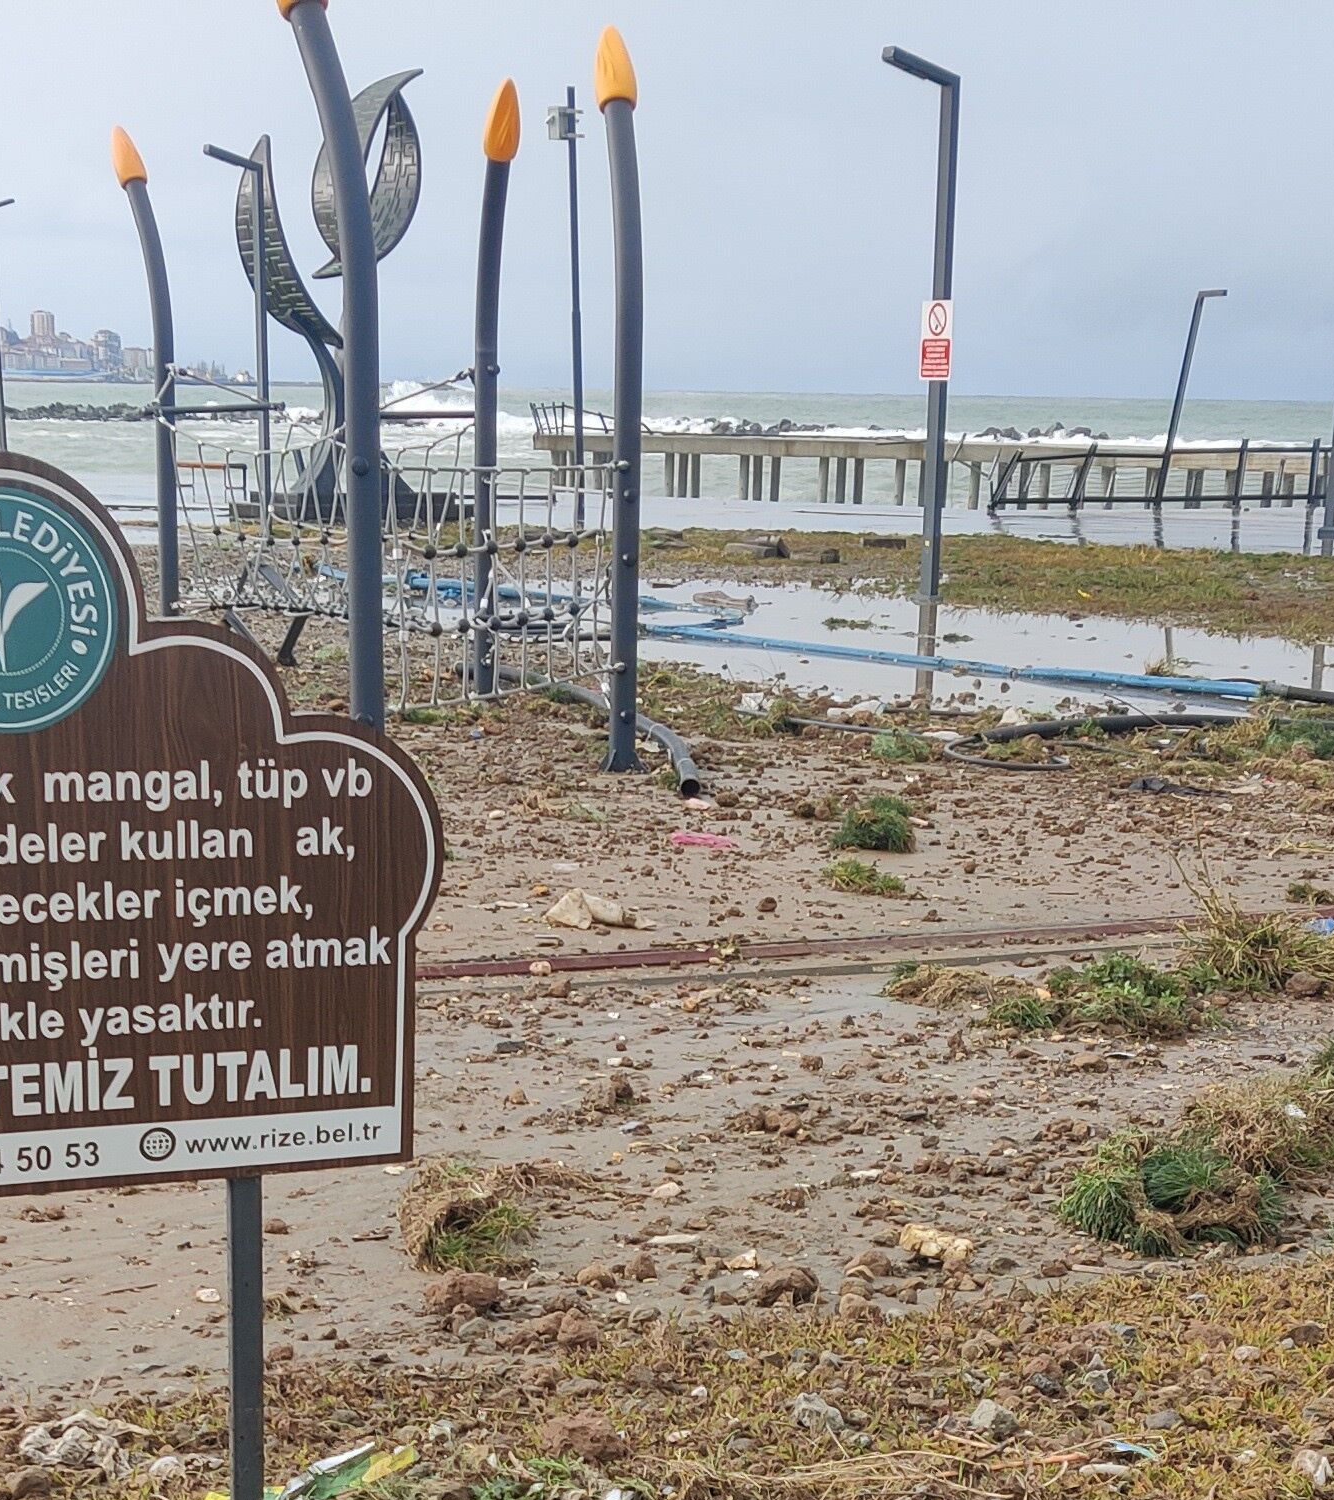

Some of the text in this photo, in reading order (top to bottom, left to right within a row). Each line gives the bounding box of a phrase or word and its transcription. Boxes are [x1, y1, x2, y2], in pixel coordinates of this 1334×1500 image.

[43, 759, 223, 812] mangal,
[237, 758, 309, 809] tüp
[321, 757, 373, 798] vb
[174, 875, 314, 928] içmek,
[156, 938, 252, 983] yere
[265, 925, 392, 970] atmak
[77, 992, 263, 1047] yasaktır.
[147, 1043, 373, 1107] TUTALIM.
[15, 1145, 52, 1173] 50
[64, 1140, 101, 1169] 53
[184, 1120, 383, 1155] www.rize.bel.tr
